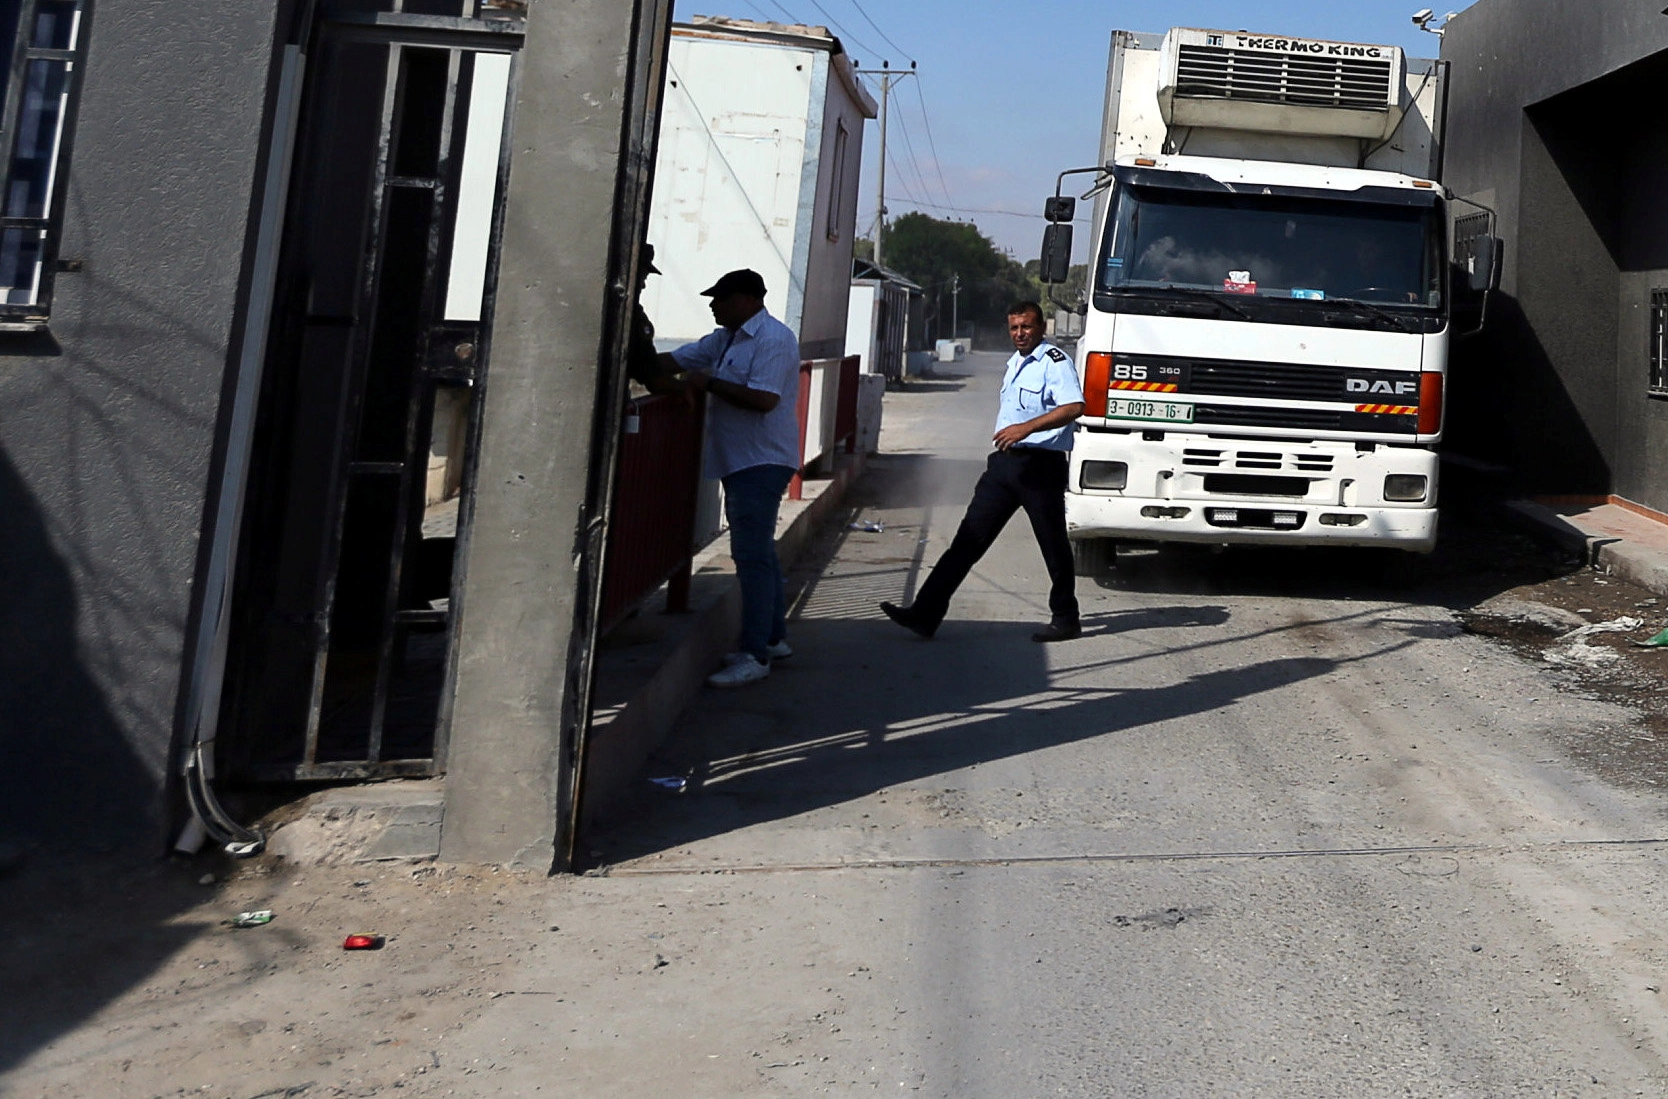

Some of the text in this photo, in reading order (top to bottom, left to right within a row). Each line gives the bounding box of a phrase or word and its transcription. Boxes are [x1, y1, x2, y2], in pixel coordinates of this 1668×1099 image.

[1236, 35, 1381, 58] THERMO KING
[1113, 364, 1181, 380] 85 360
[1346, 378, 1417, 395] DAF
